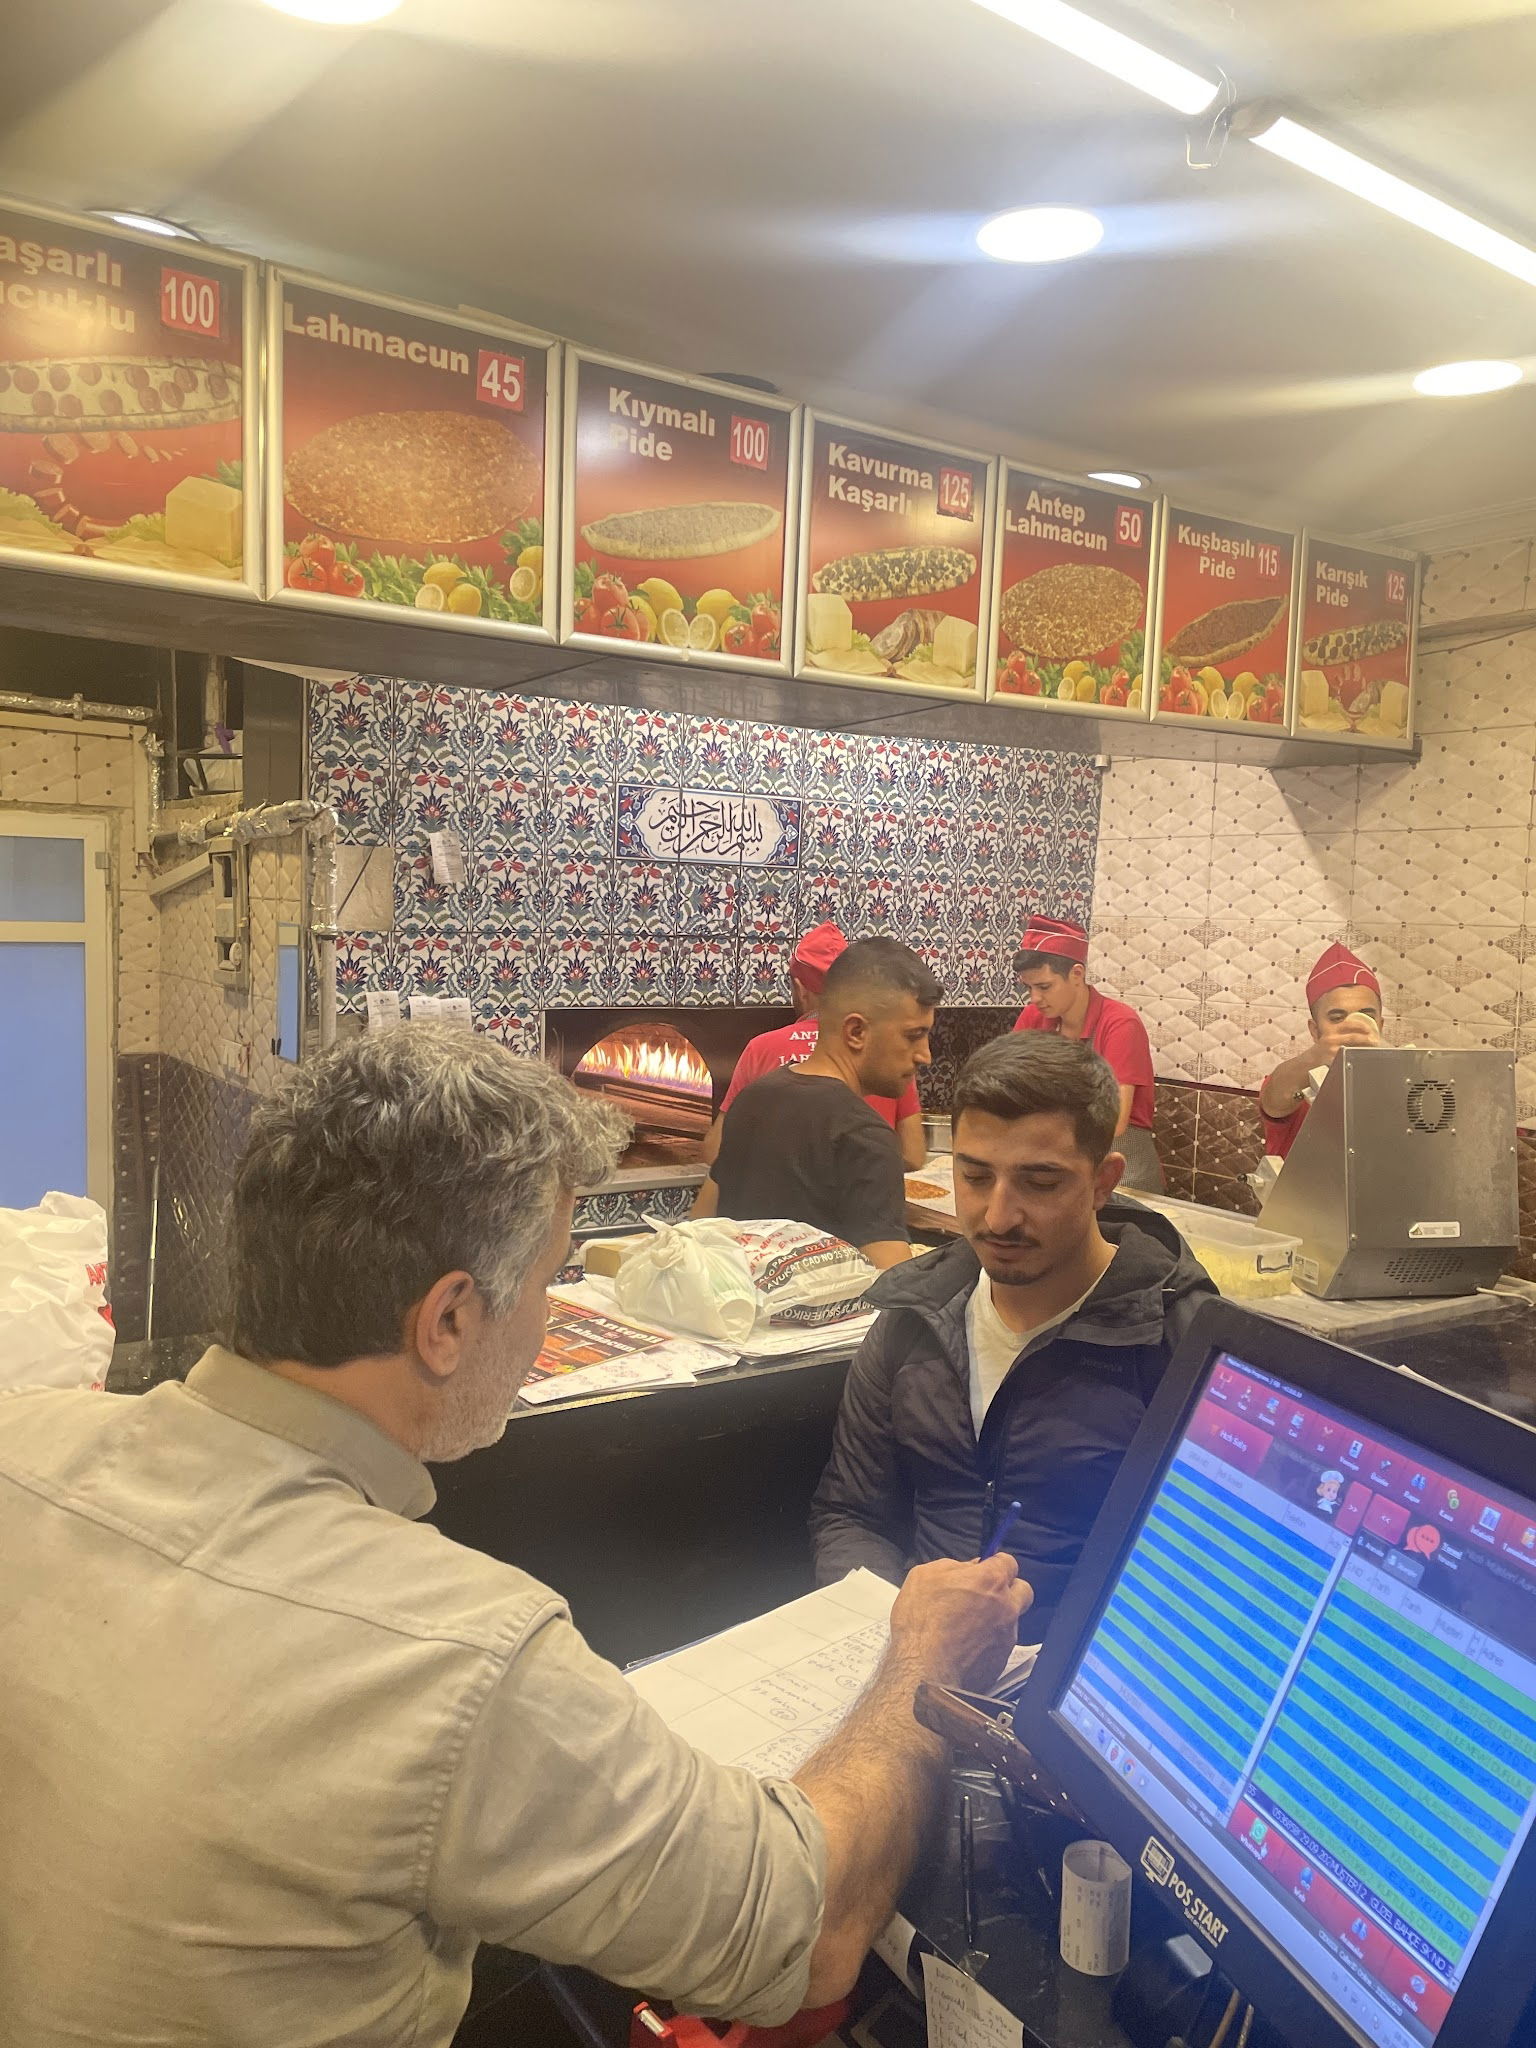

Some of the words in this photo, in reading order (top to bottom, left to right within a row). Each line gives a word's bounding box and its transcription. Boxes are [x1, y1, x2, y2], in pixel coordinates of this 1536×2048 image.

[165, 277, 214, 328] 100
[284, 302, 470, 375] Lahmacun
[481, 359, 521, 402] 45
[609, 387, 716, 437] Kıymalı
[610, 423, 673, 461] Pide
[733, 422, 765, 463] 100
[828, 442, 934, 490] Kavurma
[828, 475, 913, 516] Kaşarlı
[943, 473, 970, 508] 125
[1026, 490, 1086, 526] Antep
[1006, 509, 1107, 551] Lahmacun
[1119, 511, 1141, 542] 50
[1178, 524, 1255, 559] Kuşbaşılı
[1199, 556, 1236, 579] Pide
[1258, 548, 1278, 576] 115
[1316, 560, 1368, 590] Karışık
[1316, 584, 1349, 607] Pide
[1387, 574, 1405, 601] 125
[767, 1262, 801, 1290] AVUKAT
[803, 1255, 820, 1267] CAD
[821, 1252, 834, 1263] NO
[834, 1250, 843, 1259] 25
[589, 1318, 666, 1344] Antepli
[1168, 1872, 1194, 1907] POS
[1191, 1898, 1229, 1943] START
